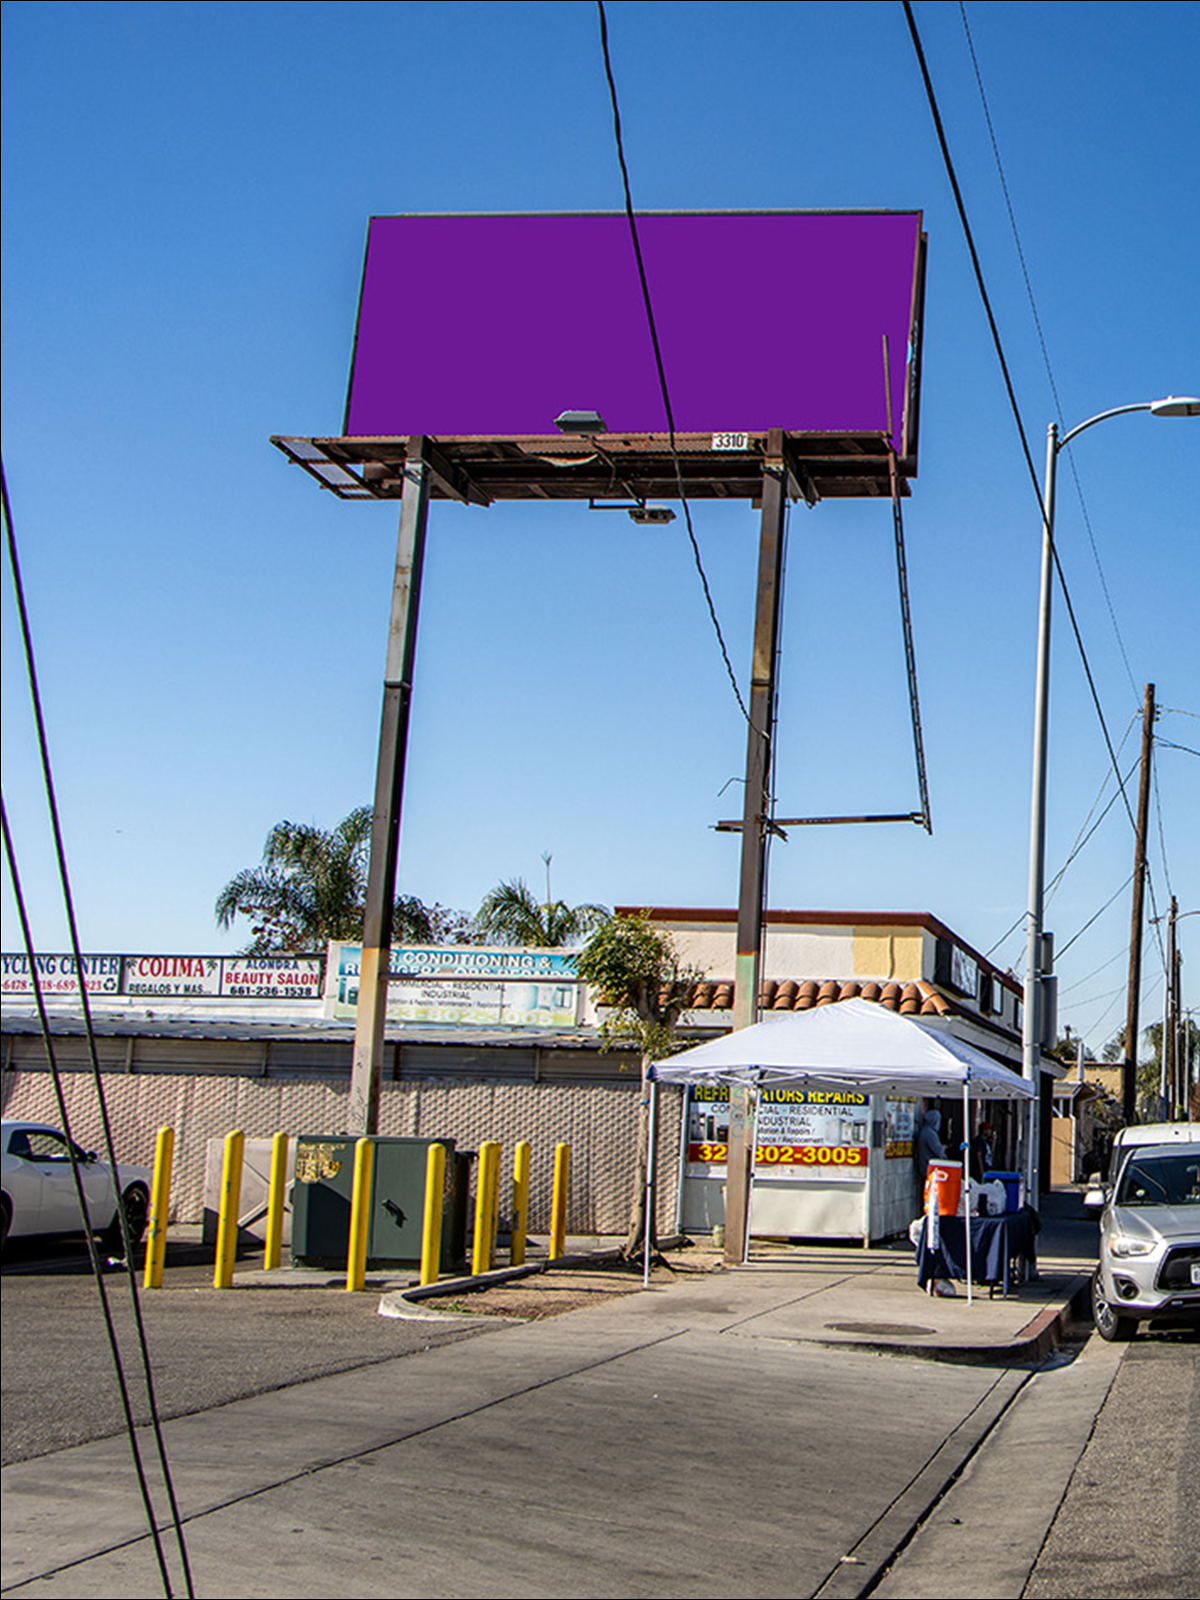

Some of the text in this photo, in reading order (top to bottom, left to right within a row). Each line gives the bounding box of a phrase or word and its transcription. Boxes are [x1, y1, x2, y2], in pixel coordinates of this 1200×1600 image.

[714, 433, 744, 448] 3310
[3, 957, 56, 975] YCLNG
[245, 960, 301, 971] ALONDRA
[404, 952, 536, 967] CONDITIONING
[541, 957, 553, 969] &
[139, 957, 206, 978] COLIMA
[225, 972, 319, 985] BEAUTY SALON
[128, 984, 171, 994] REGALOS
[174, 984, 181, 994] Y
[807, 1091, 866, 1104] REPAIRS
[789, 1106, 854, 1117] RESIDENTIAL
[757, 1116, 811, 1127] DUSTRIAL
